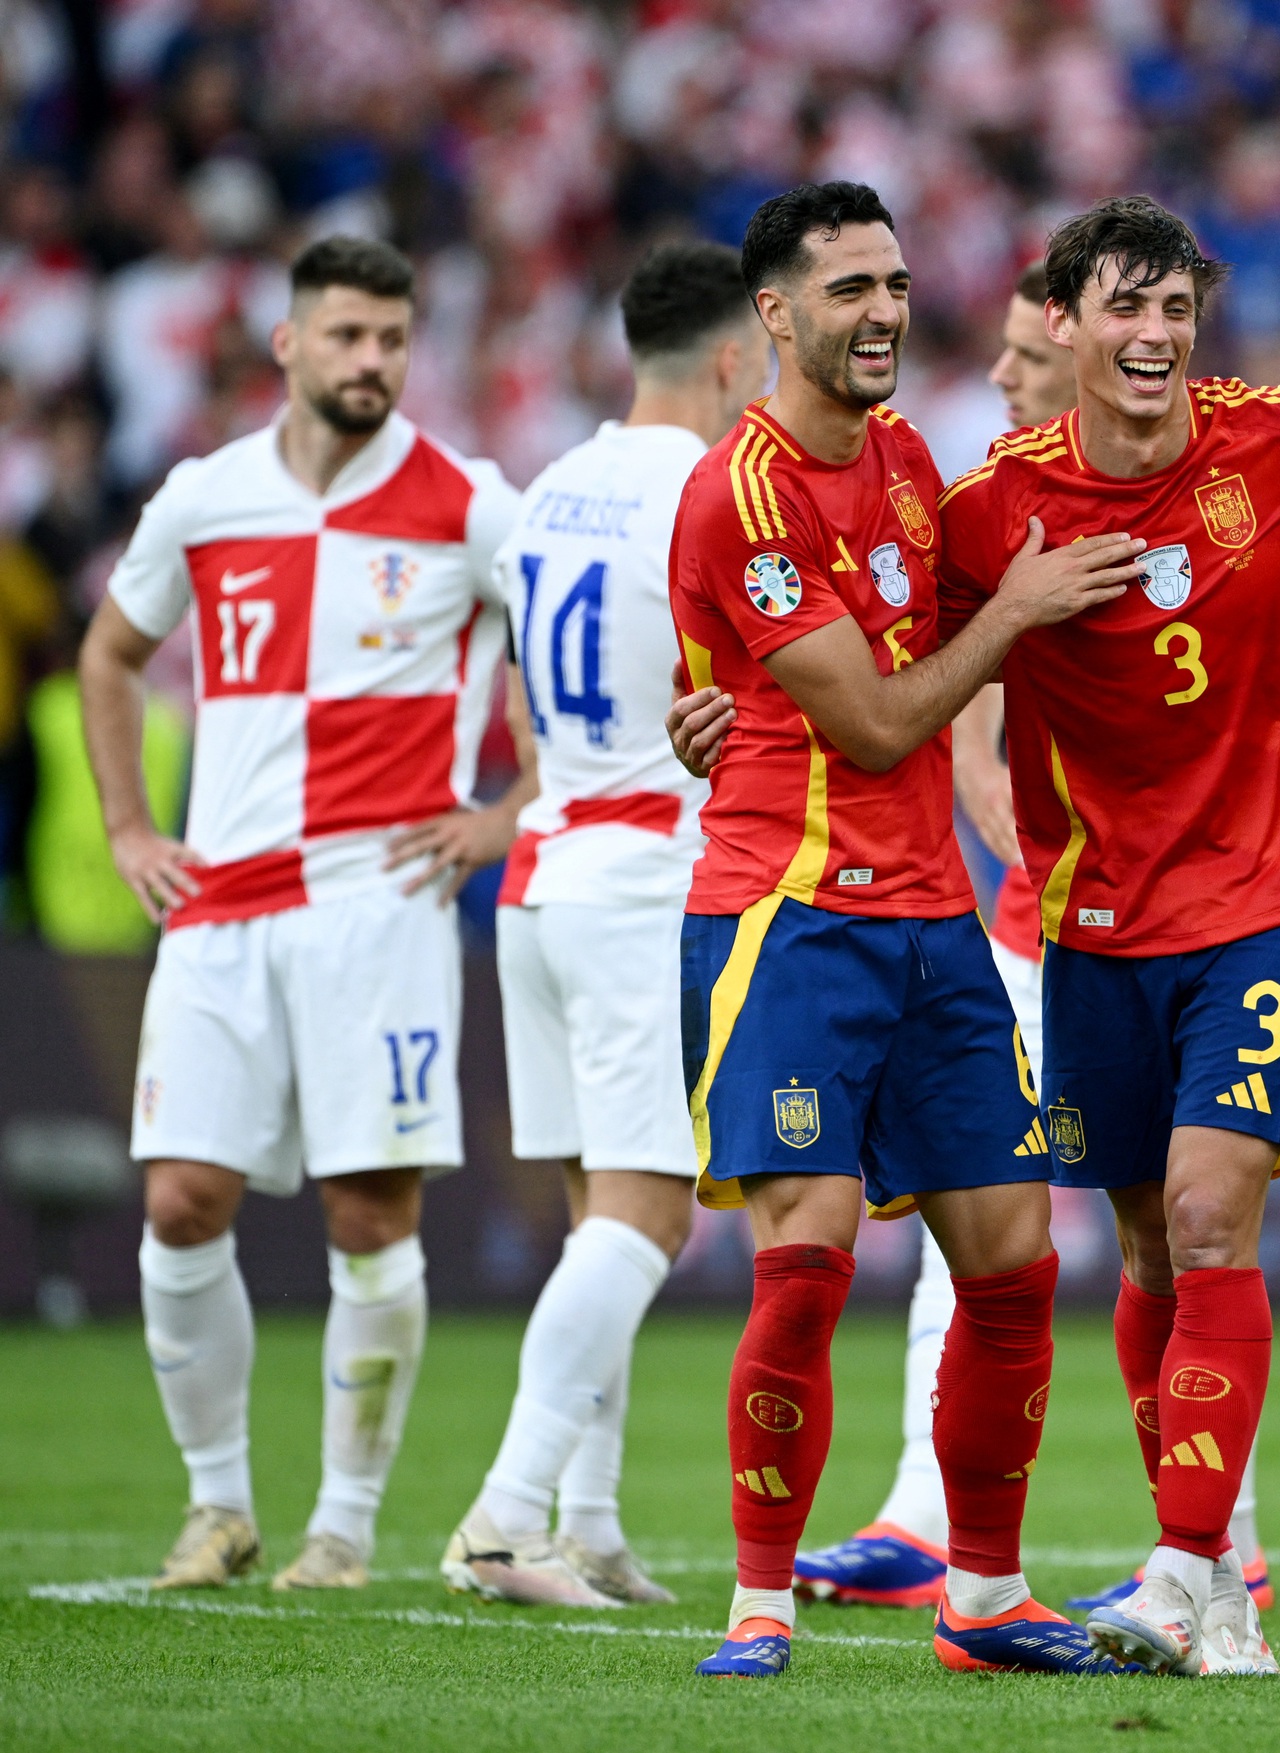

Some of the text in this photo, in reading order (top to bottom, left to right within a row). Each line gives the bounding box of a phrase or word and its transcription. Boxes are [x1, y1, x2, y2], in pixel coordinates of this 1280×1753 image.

[217, 600, 275, 683] 17
[520, 553, 616, 748] 14
[1153, 621, 1209, 706] 3
[384, 1030, 440, 1105] 17
